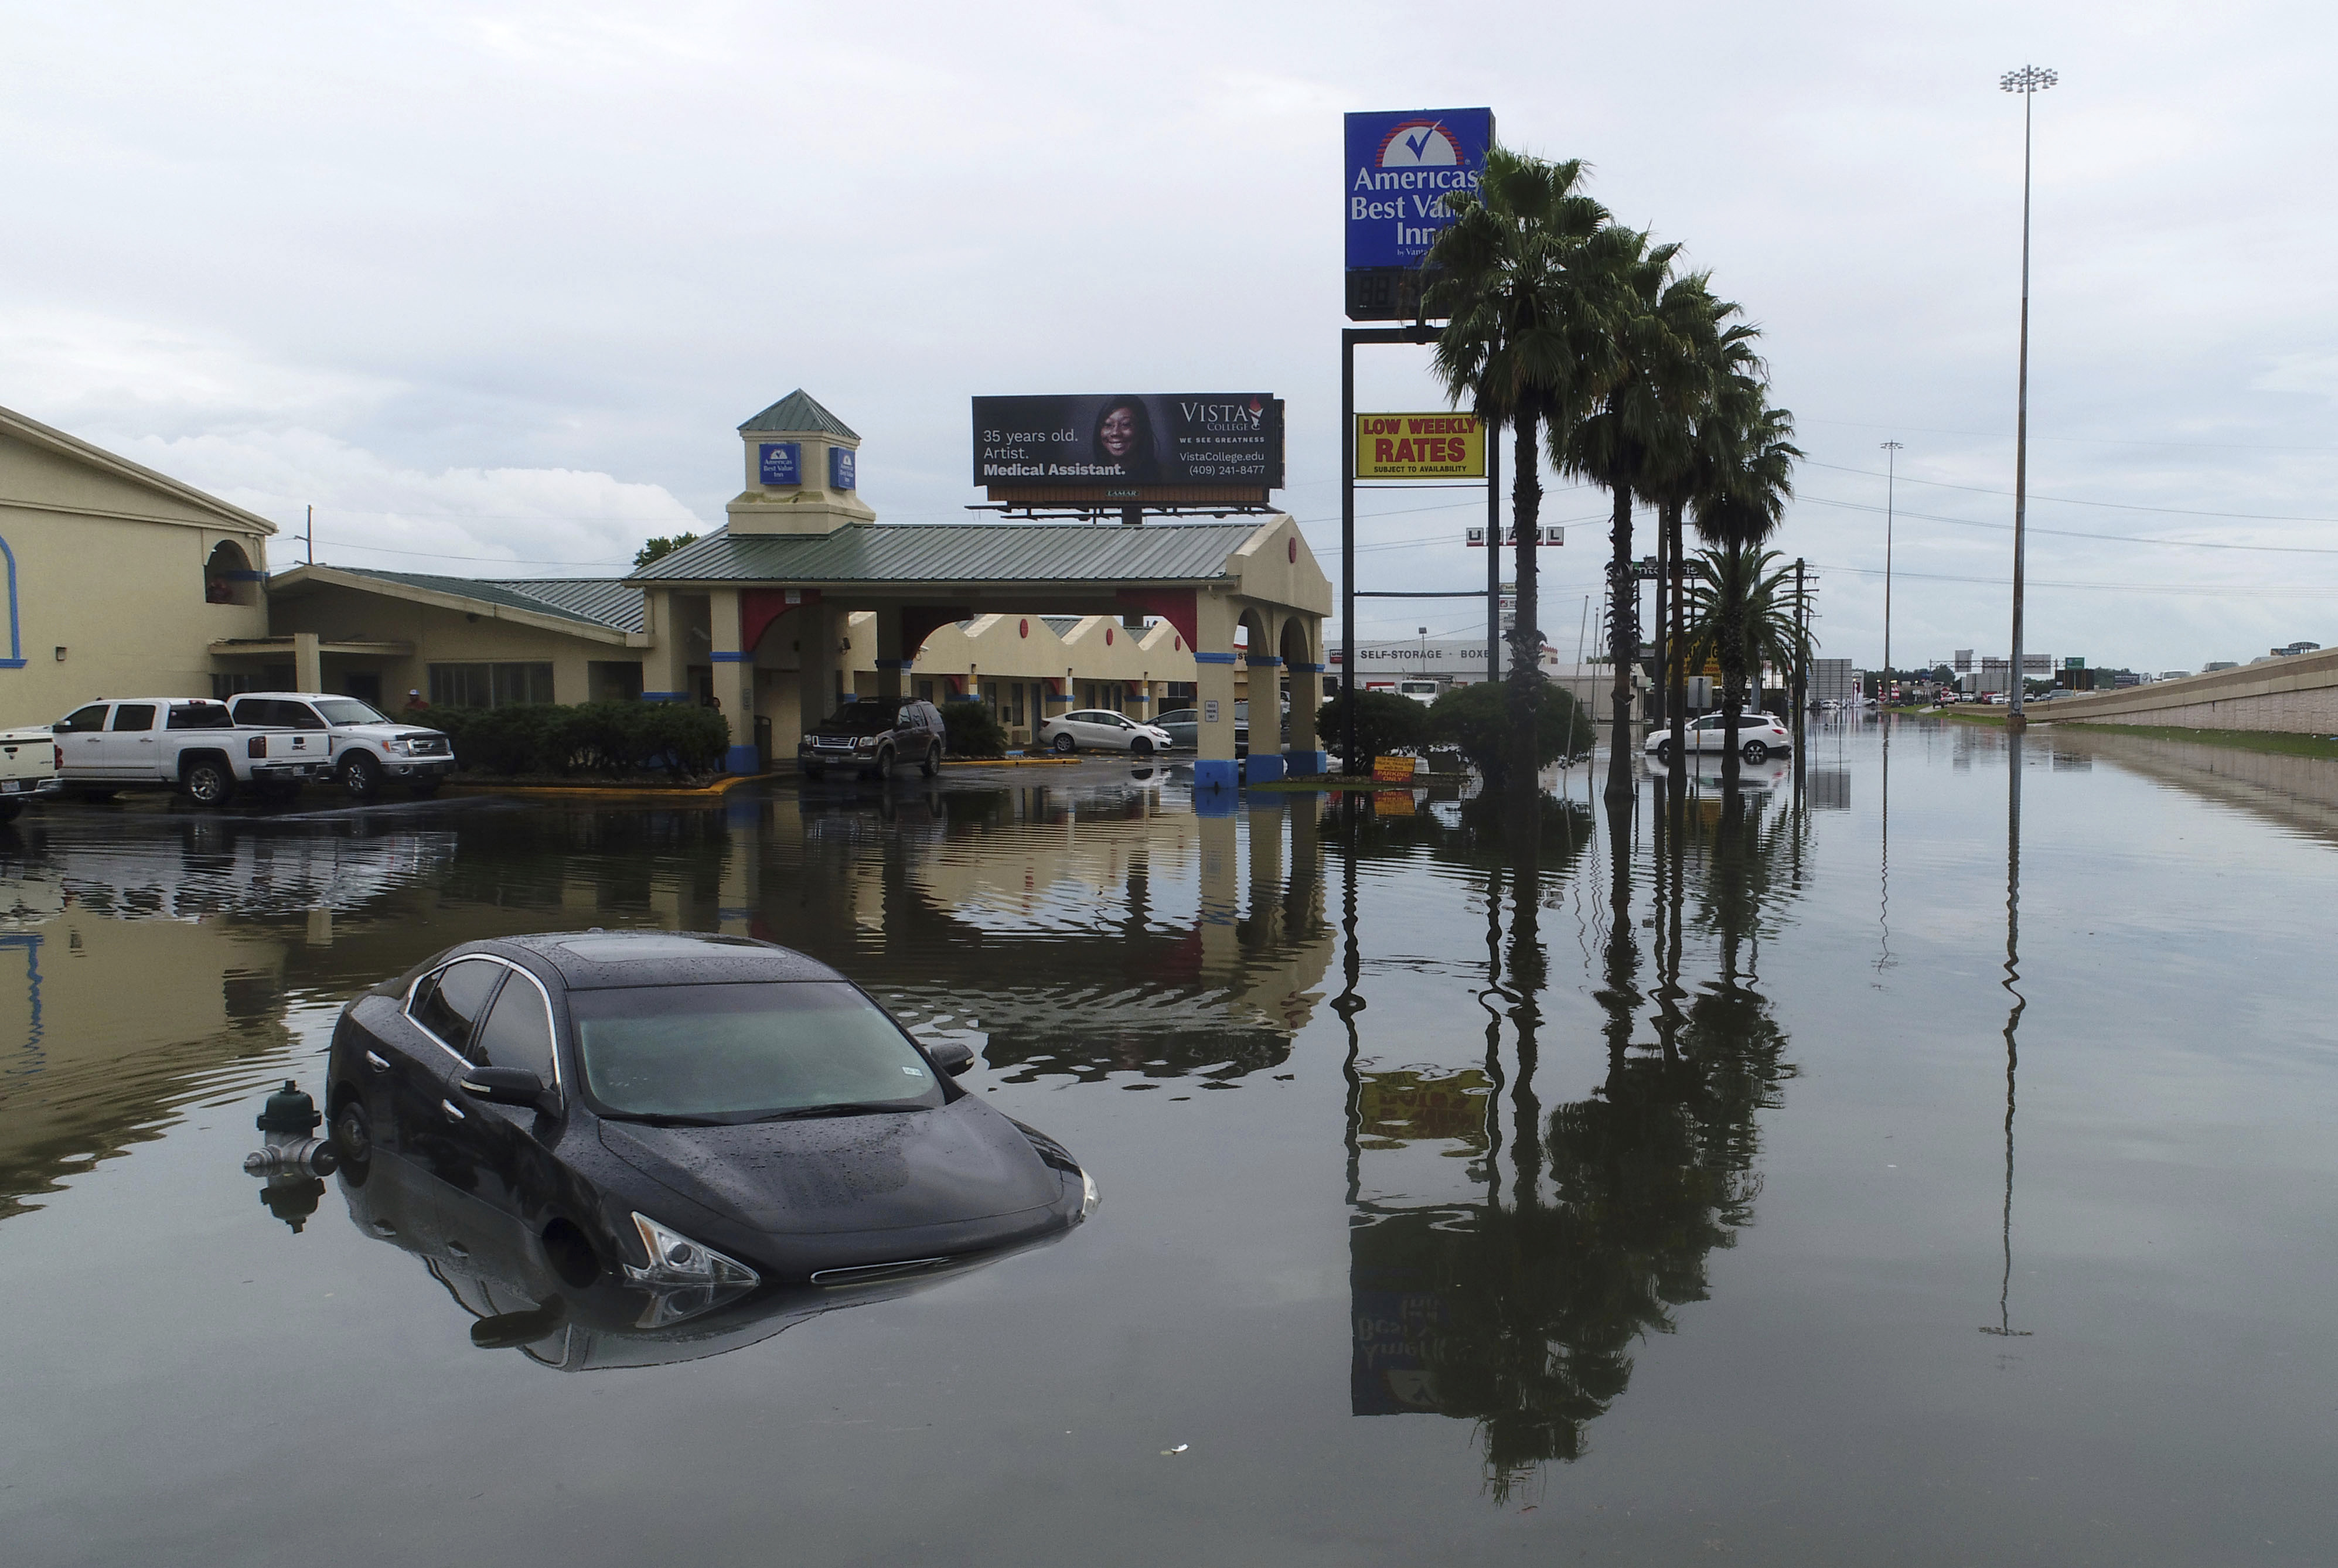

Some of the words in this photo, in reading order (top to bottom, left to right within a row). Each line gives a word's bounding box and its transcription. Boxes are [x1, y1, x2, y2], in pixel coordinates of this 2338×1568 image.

[1354, 166, 1478, 192] Americas
[1351, 196, 1406, 220] Best
[1364, 418, 1402, 435] LOW
[1408, 417, 1478, 434] WEEKLY
[983, 430, 1000, 442] 35
[1006, 431, 1046, 445] years
[1051, 428, 1078, 442] old.
[983, 446, 1030, 459] Artist.
[1179, 451, 1265, 463] VistaCollege.edu
[1375, 437, 1466, 462] RATES
[983, 463, 1045, 476] Medical
[1048, 462, 1126, 476] Assistant.
[1190, 465, 1215, 476] (409)
[1219, 465, 1265, 475] 241-8477
[1360, 650, 1442, 659] SELF-STORAGE
[1461, 649, 1490, 658] BOXE
